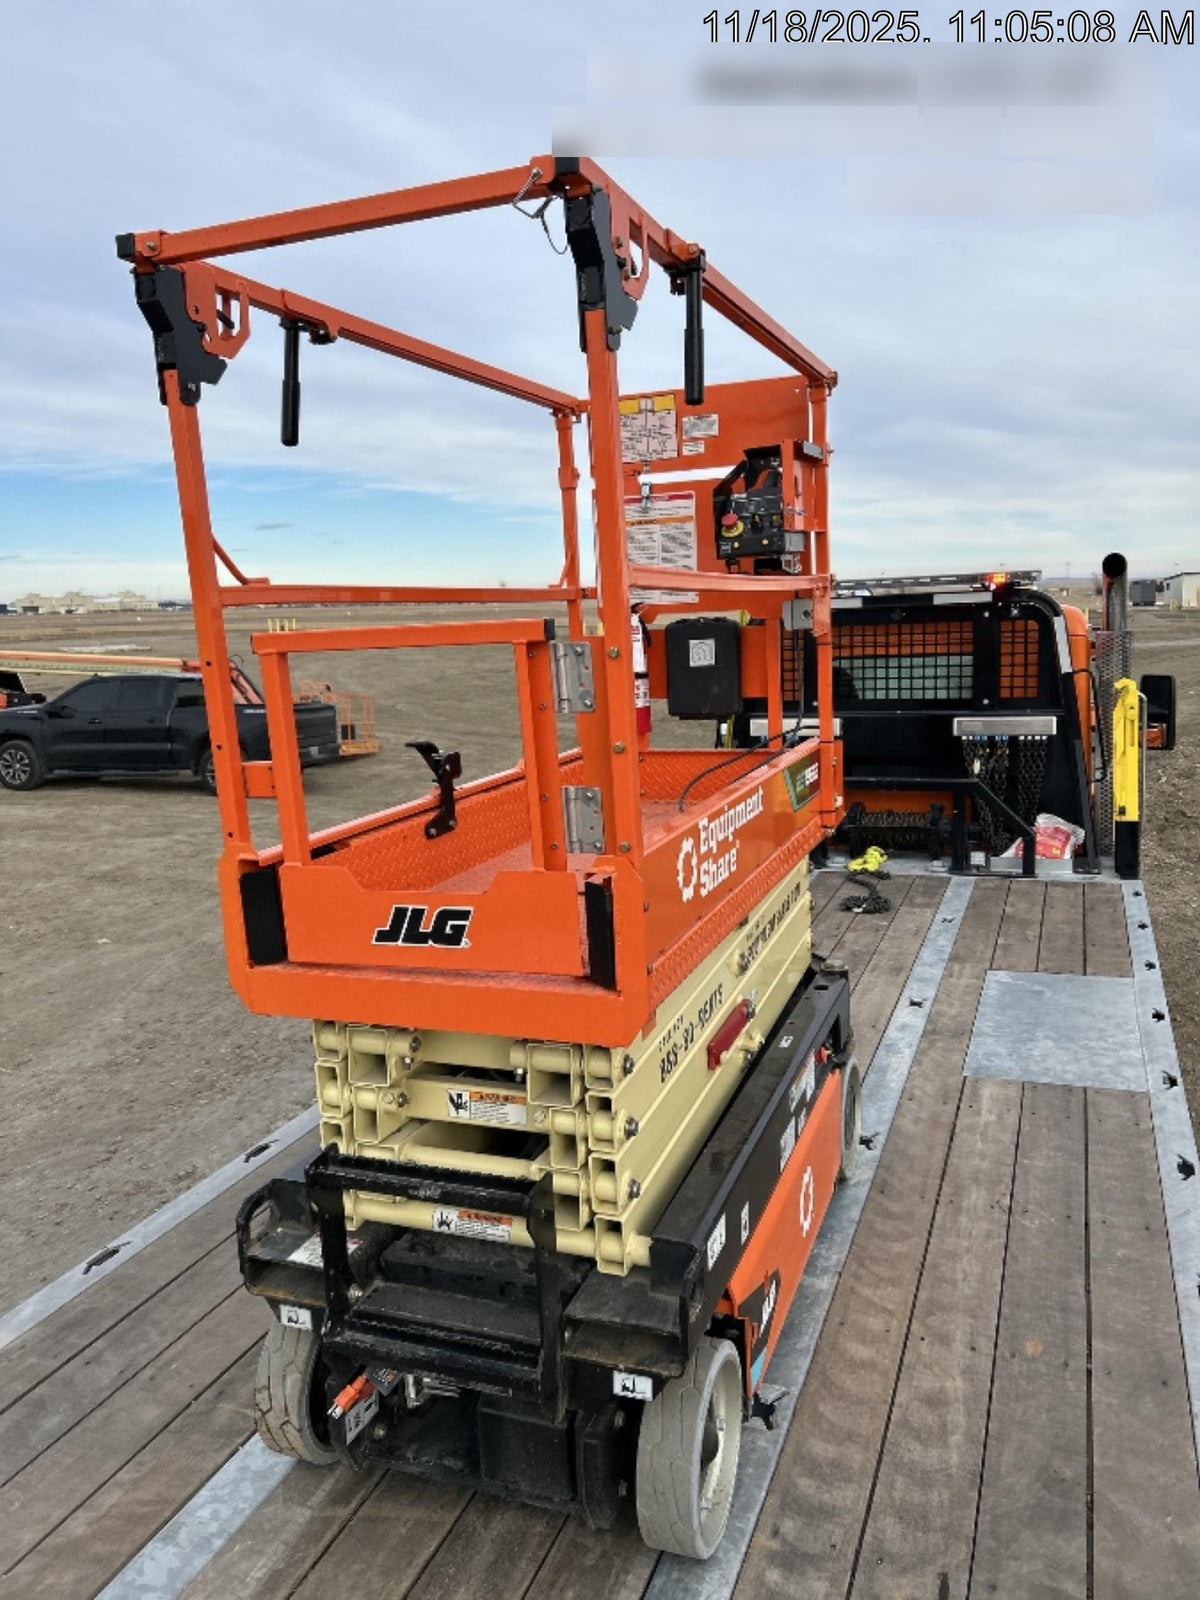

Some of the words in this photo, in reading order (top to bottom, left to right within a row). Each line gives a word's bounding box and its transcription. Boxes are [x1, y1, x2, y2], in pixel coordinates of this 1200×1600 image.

[699, 785, 763, 854] Equipment
[700, 846, 738, 898] Share
[373, 905, 473, 948] JLG
